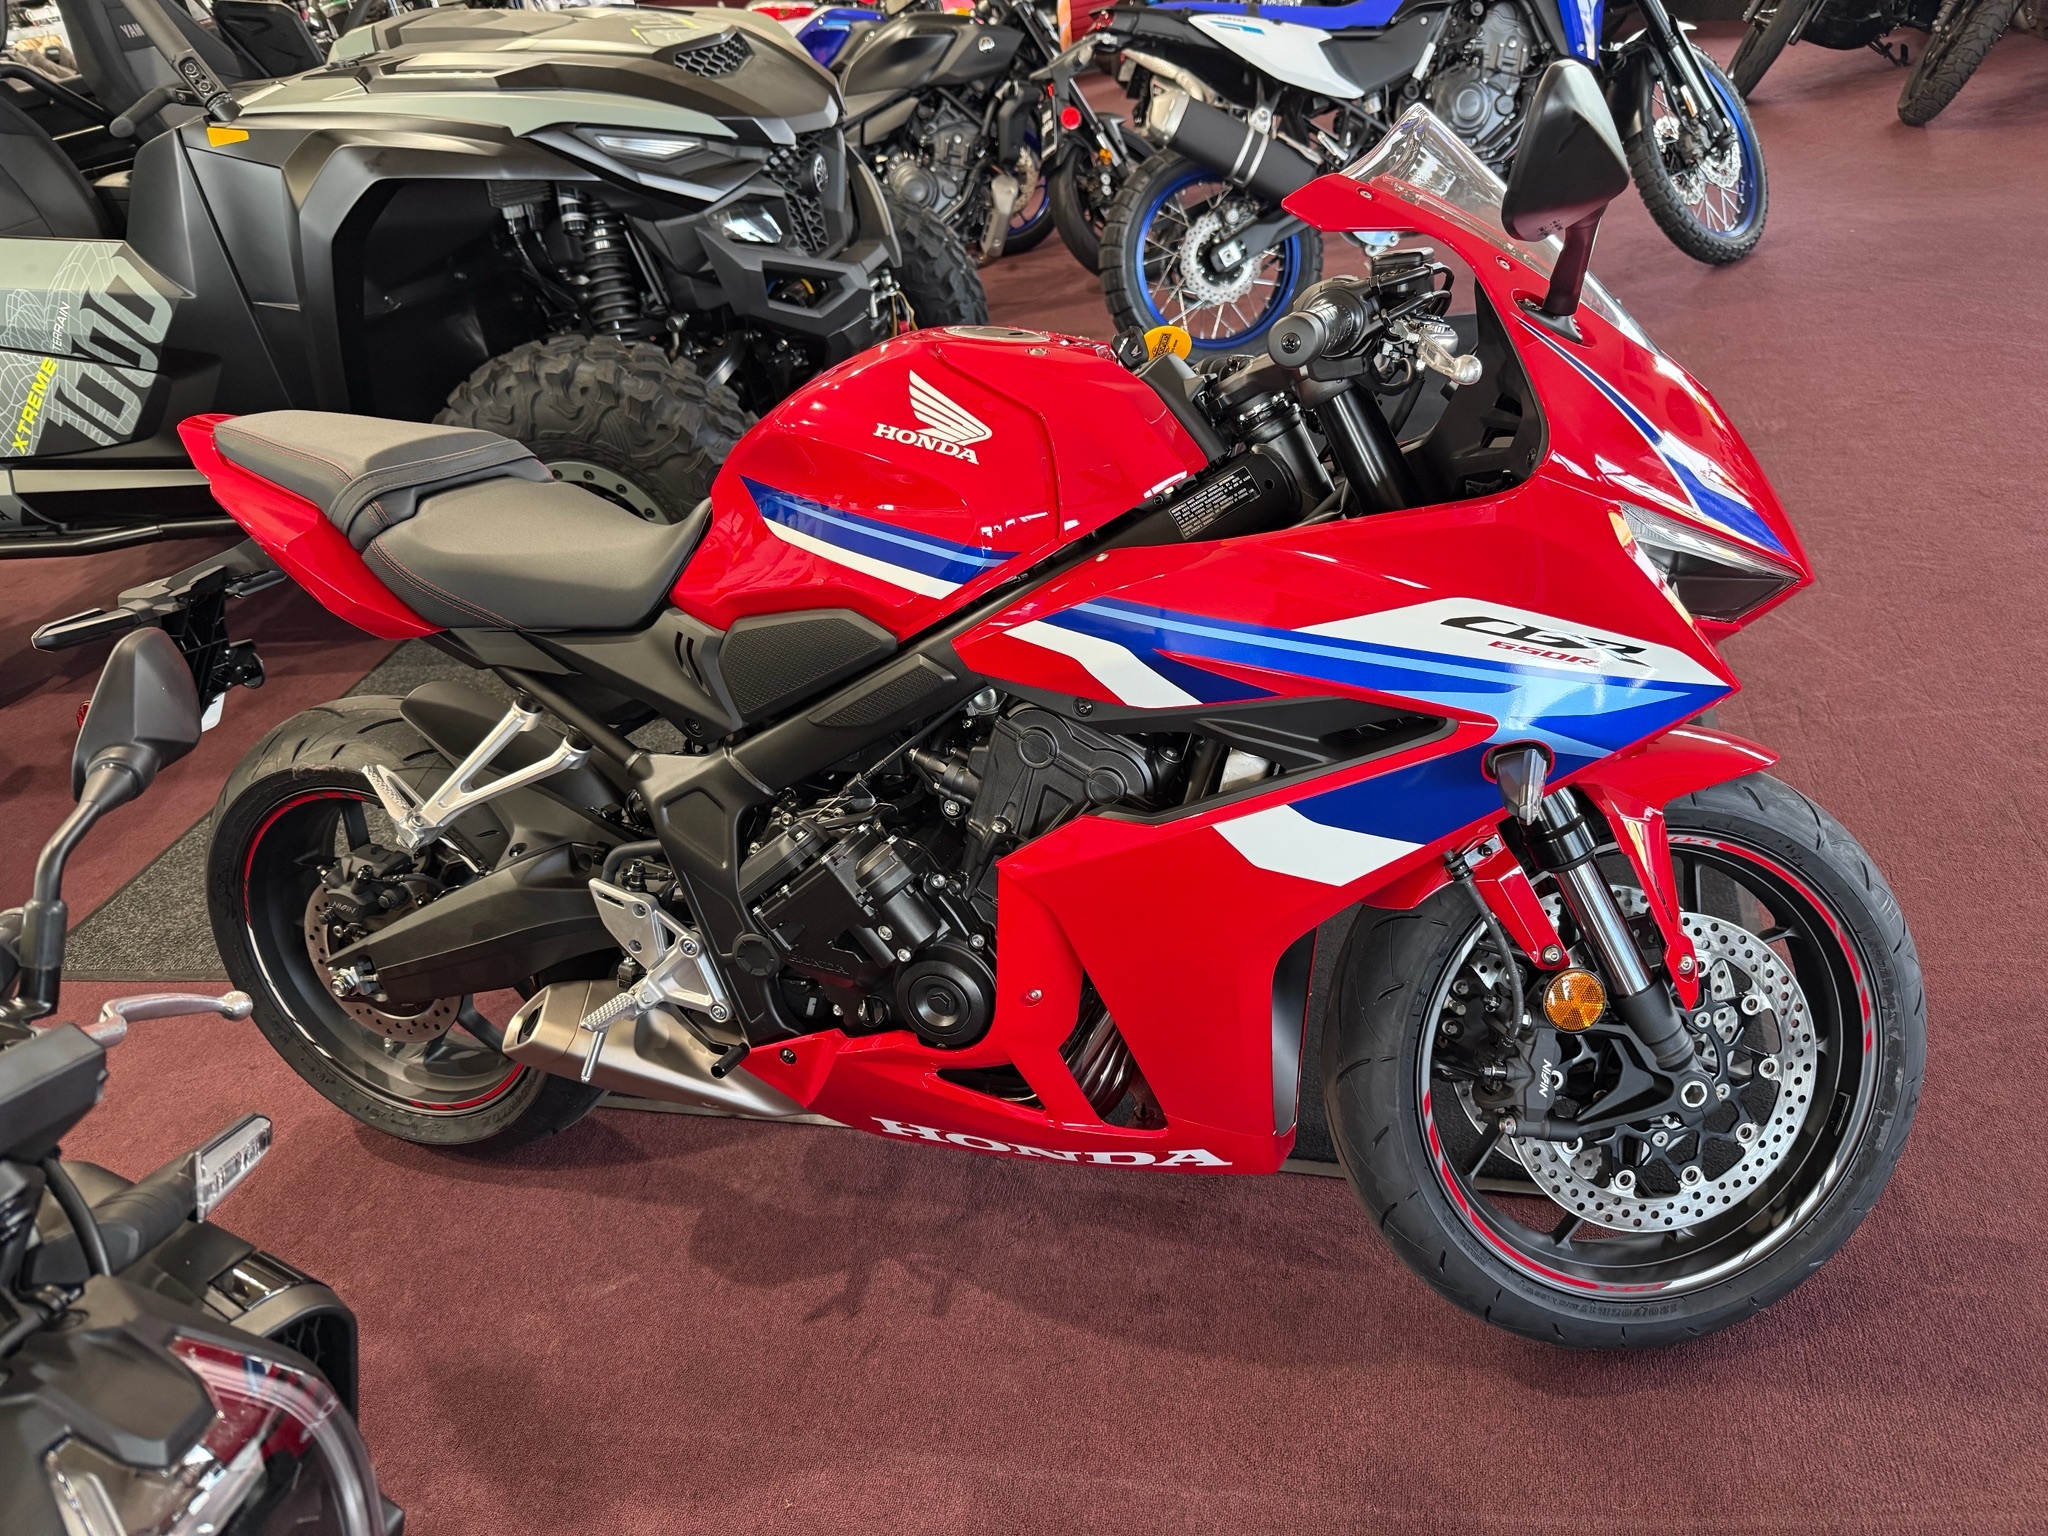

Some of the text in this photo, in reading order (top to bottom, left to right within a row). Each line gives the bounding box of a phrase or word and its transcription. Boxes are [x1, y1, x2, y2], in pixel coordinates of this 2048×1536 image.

[120, 23, 145, 38] YAM
[46, 255, 173, 447] 1000
[12, 301, 71, 455] XTREME TERRAIN
[872, 422, 980, 465] HONDA
[1440, 616, 1652, 668] CBR
[1487, 641, 1600, 668] 650R
[1668, 835, 1711, 848] BR
[1539, 1058, 1552, 1098] NISSIN
[870, 1116, 1233, 1167] HONDA
